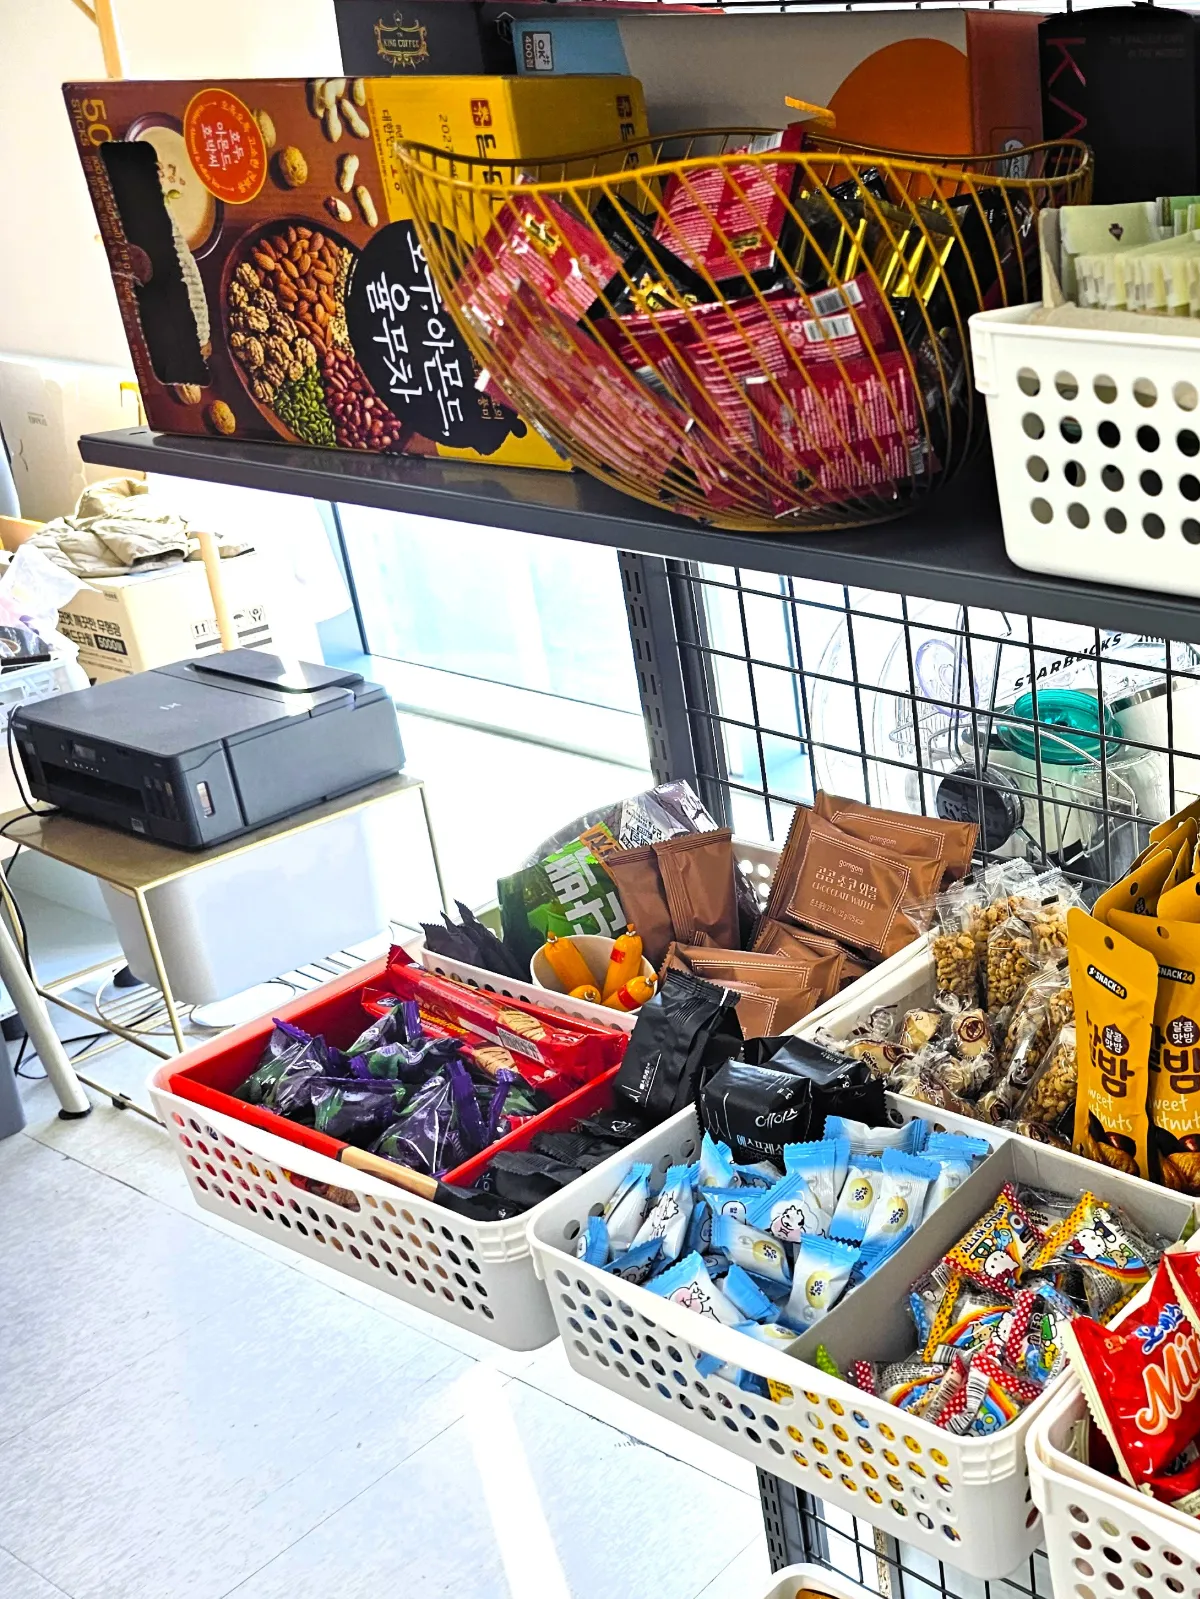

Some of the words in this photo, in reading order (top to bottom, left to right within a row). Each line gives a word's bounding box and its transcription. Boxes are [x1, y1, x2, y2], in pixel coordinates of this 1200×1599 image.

[71, 99, 90, 146] STICKS
[82, 99, 112, 147] 50
[201, 123, 220, 169] 호박씨
[216, 120, 232, 171] 아몬드,
[366, 271, 423, 404] 율무차
[868, 834, 897, 846] gomgom
[838, 859, 864, 875] gomgom
[812, 881, 850, 901] CHOCOLATE
[851, 895, 876, 912] WAFFLE
[815, 865, 837, 884] 곰곰
[837, 874, 857, 892] 초코
[859, 881, 878, 901] 와플
[1094, 970, 1126, 997] SNACK24
[1105, 1026, 1123, 1043] 달콤
[1171, 1020, 1195, 1034] 달콤
[1171, 1031, 1195, 1045] 맛밤
[1103, 1038, 1123, 1053] 맛밤
[1148, 1093, 1187, 1113] weet
[754, 1107, 800, 1129] 에이스
[736, 1134, 785, 1154] 에스프레소
[983, 1203, 1010, 1231] HELLO
[960, 1227, 987, 1255] KITTY
[1135, 1303, 1185, 1355] 오예스
